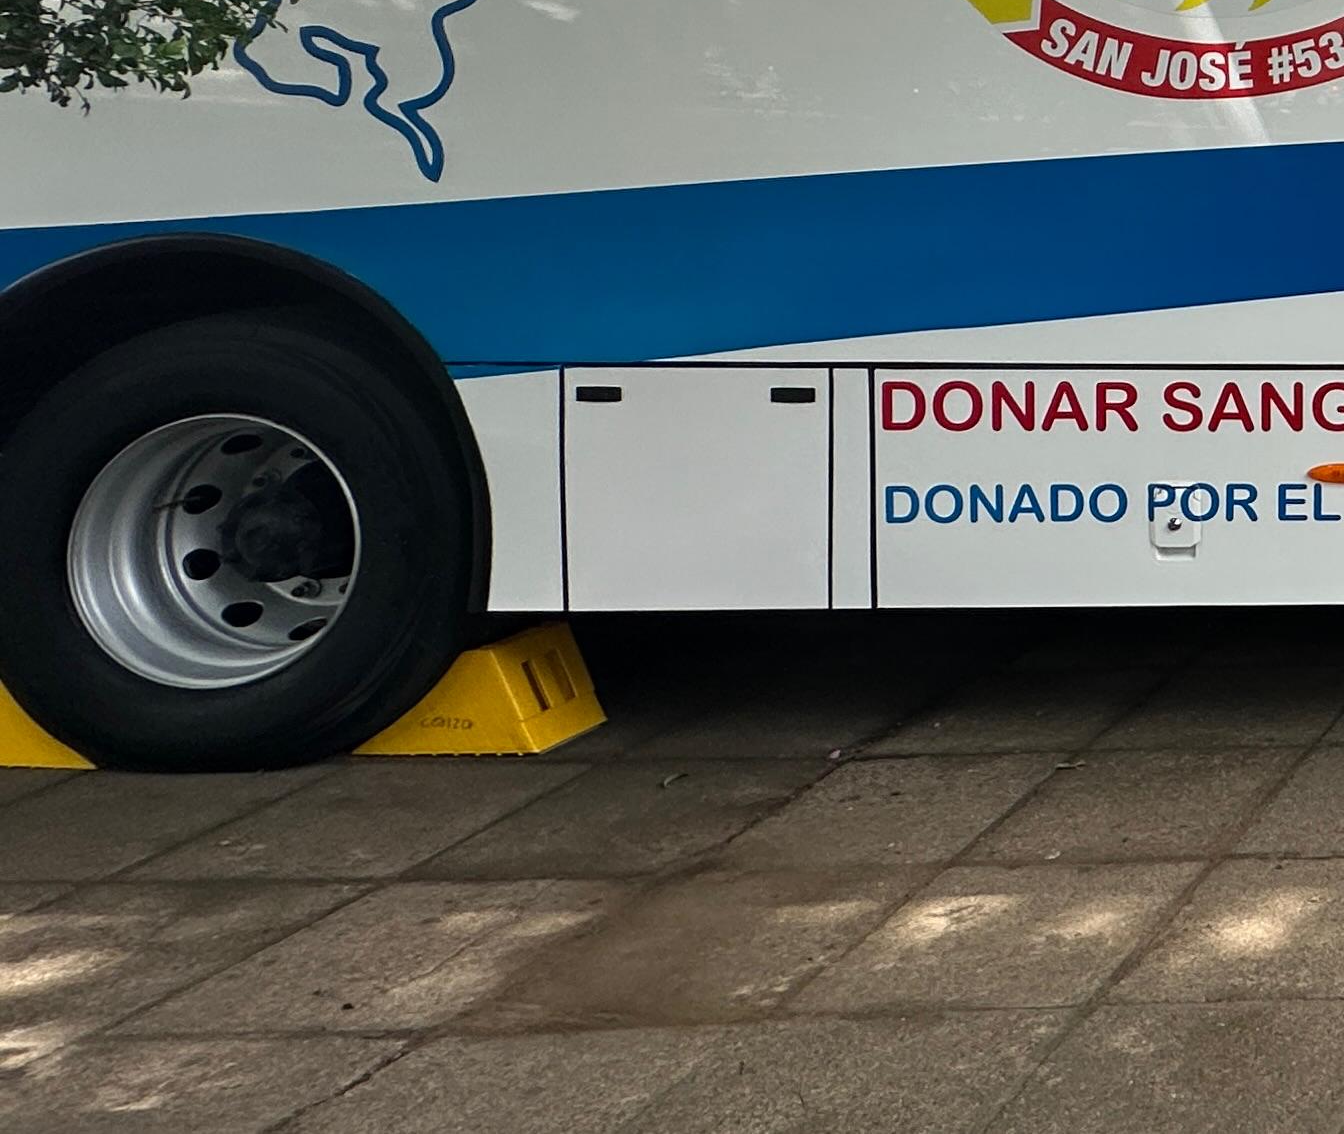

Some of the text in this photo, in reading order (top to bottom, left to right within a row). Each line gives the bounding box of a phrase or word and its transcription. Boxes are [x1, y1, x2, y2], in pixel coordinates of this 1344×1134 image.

[1040, 17, 1133, 81] SAN
[1140, 41, 1254, 92] JOSÉ
[881, 381, 1139, 433] DONAR
[884, 483, 1129, 524] DONADO
[1146, 483, 1259, 523] POR
[1276, 483, 1342, 523] EL
